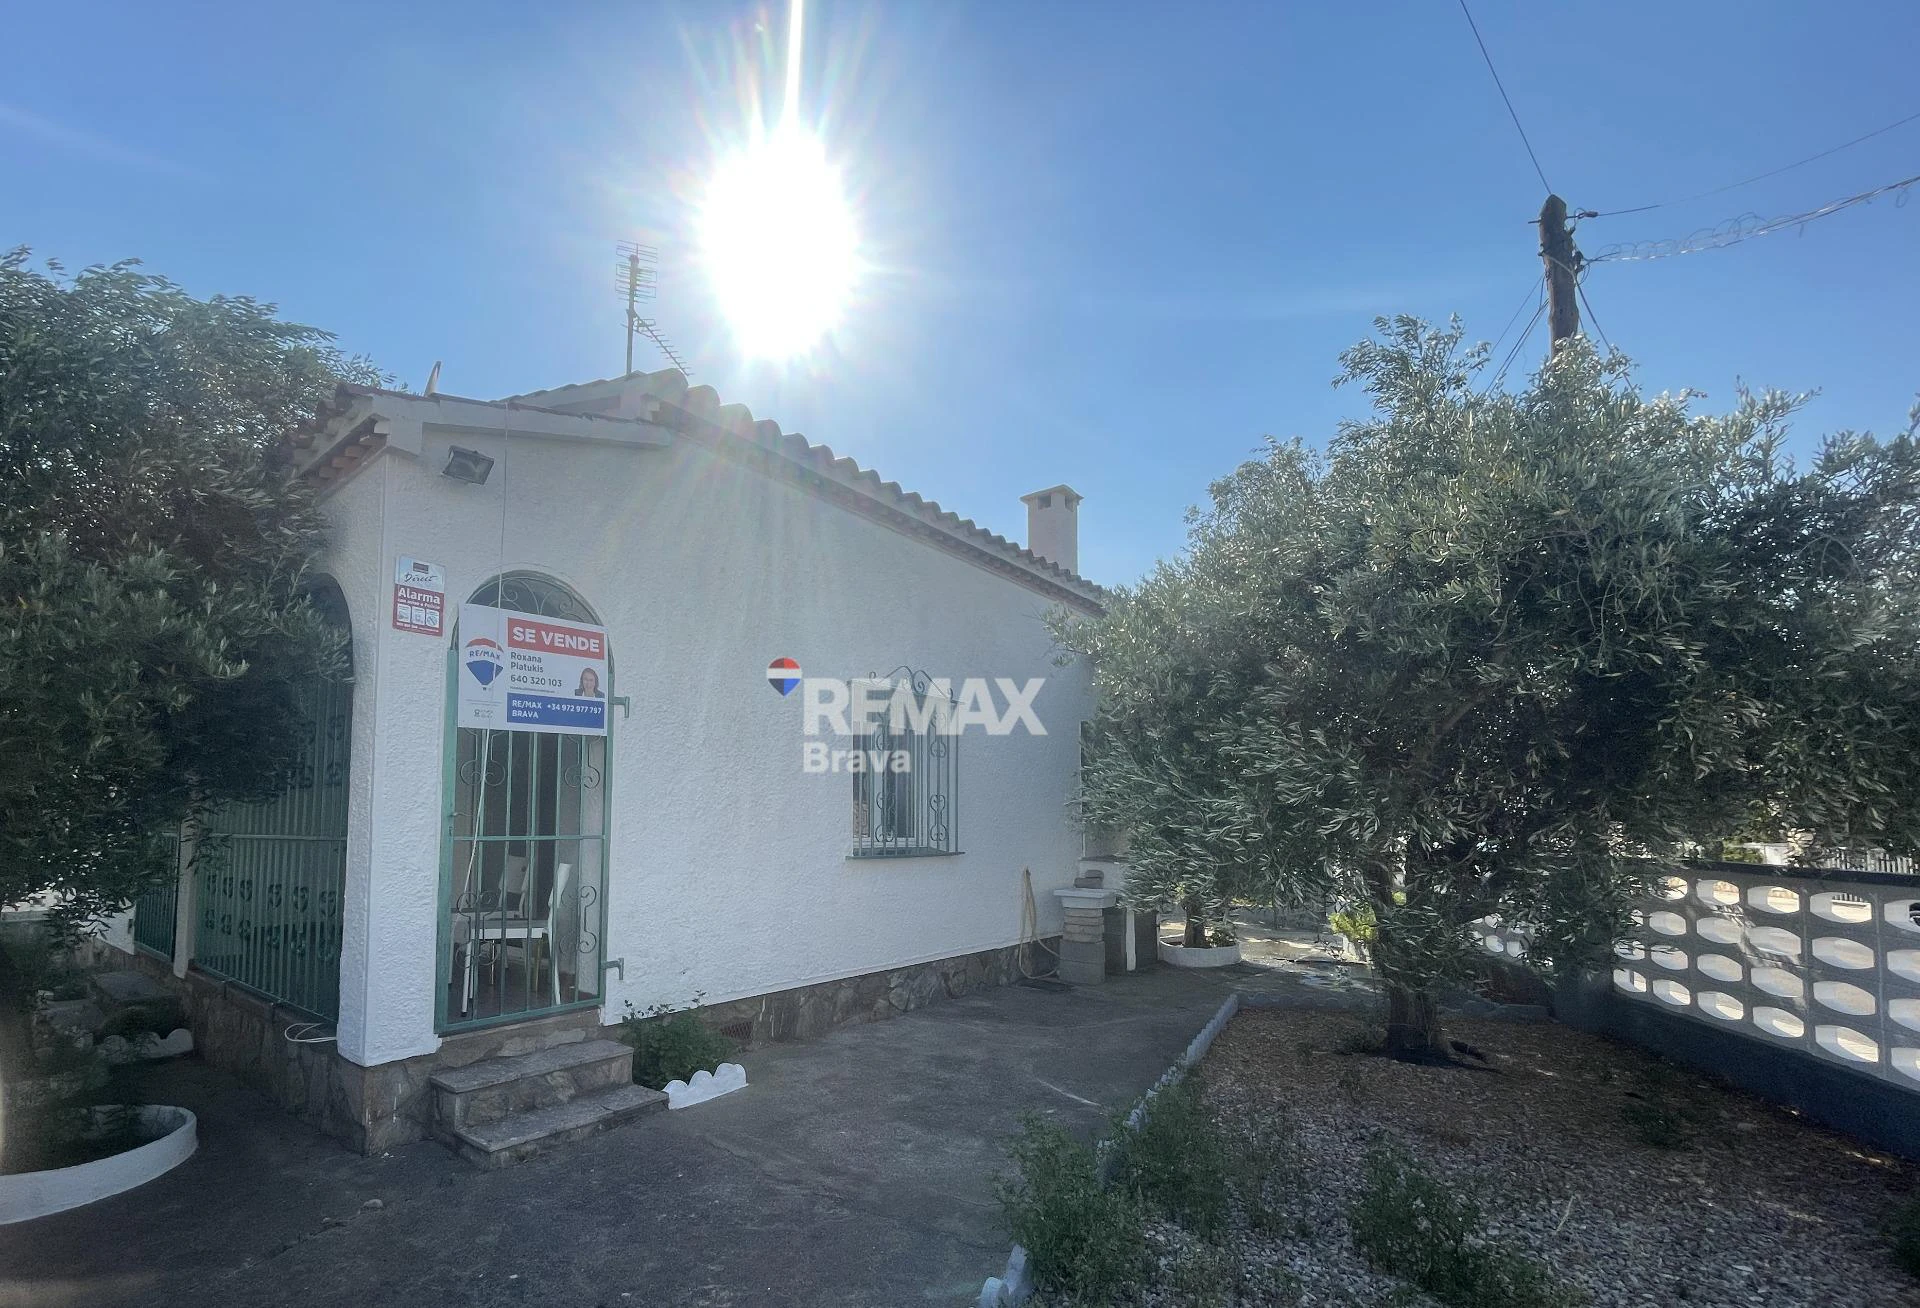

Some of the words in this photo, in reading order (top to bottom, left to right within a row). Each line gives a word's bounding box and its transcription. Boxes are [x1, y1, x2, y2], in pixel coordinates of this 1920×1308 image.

[398, 587, 440, 605] Alarma
[512, 626, 536, 643] SE
[541, 631, 600, 653] VENDE
[469, 649, 501, 660] RE/MAX
[510, 651, 542, 663] Roxana
[510, 674, 528, 684] 640
[530, 676, 546, 686] 320
[548, 678, 562, 688] 103
[512, 699, 542, 709] RE/MAX
[547, 703, 560, 711] +34
[561, 704, 575, 712] 972
[576, 705, 588, 713] 977
[512, 709, 539, 719] BRAVA
